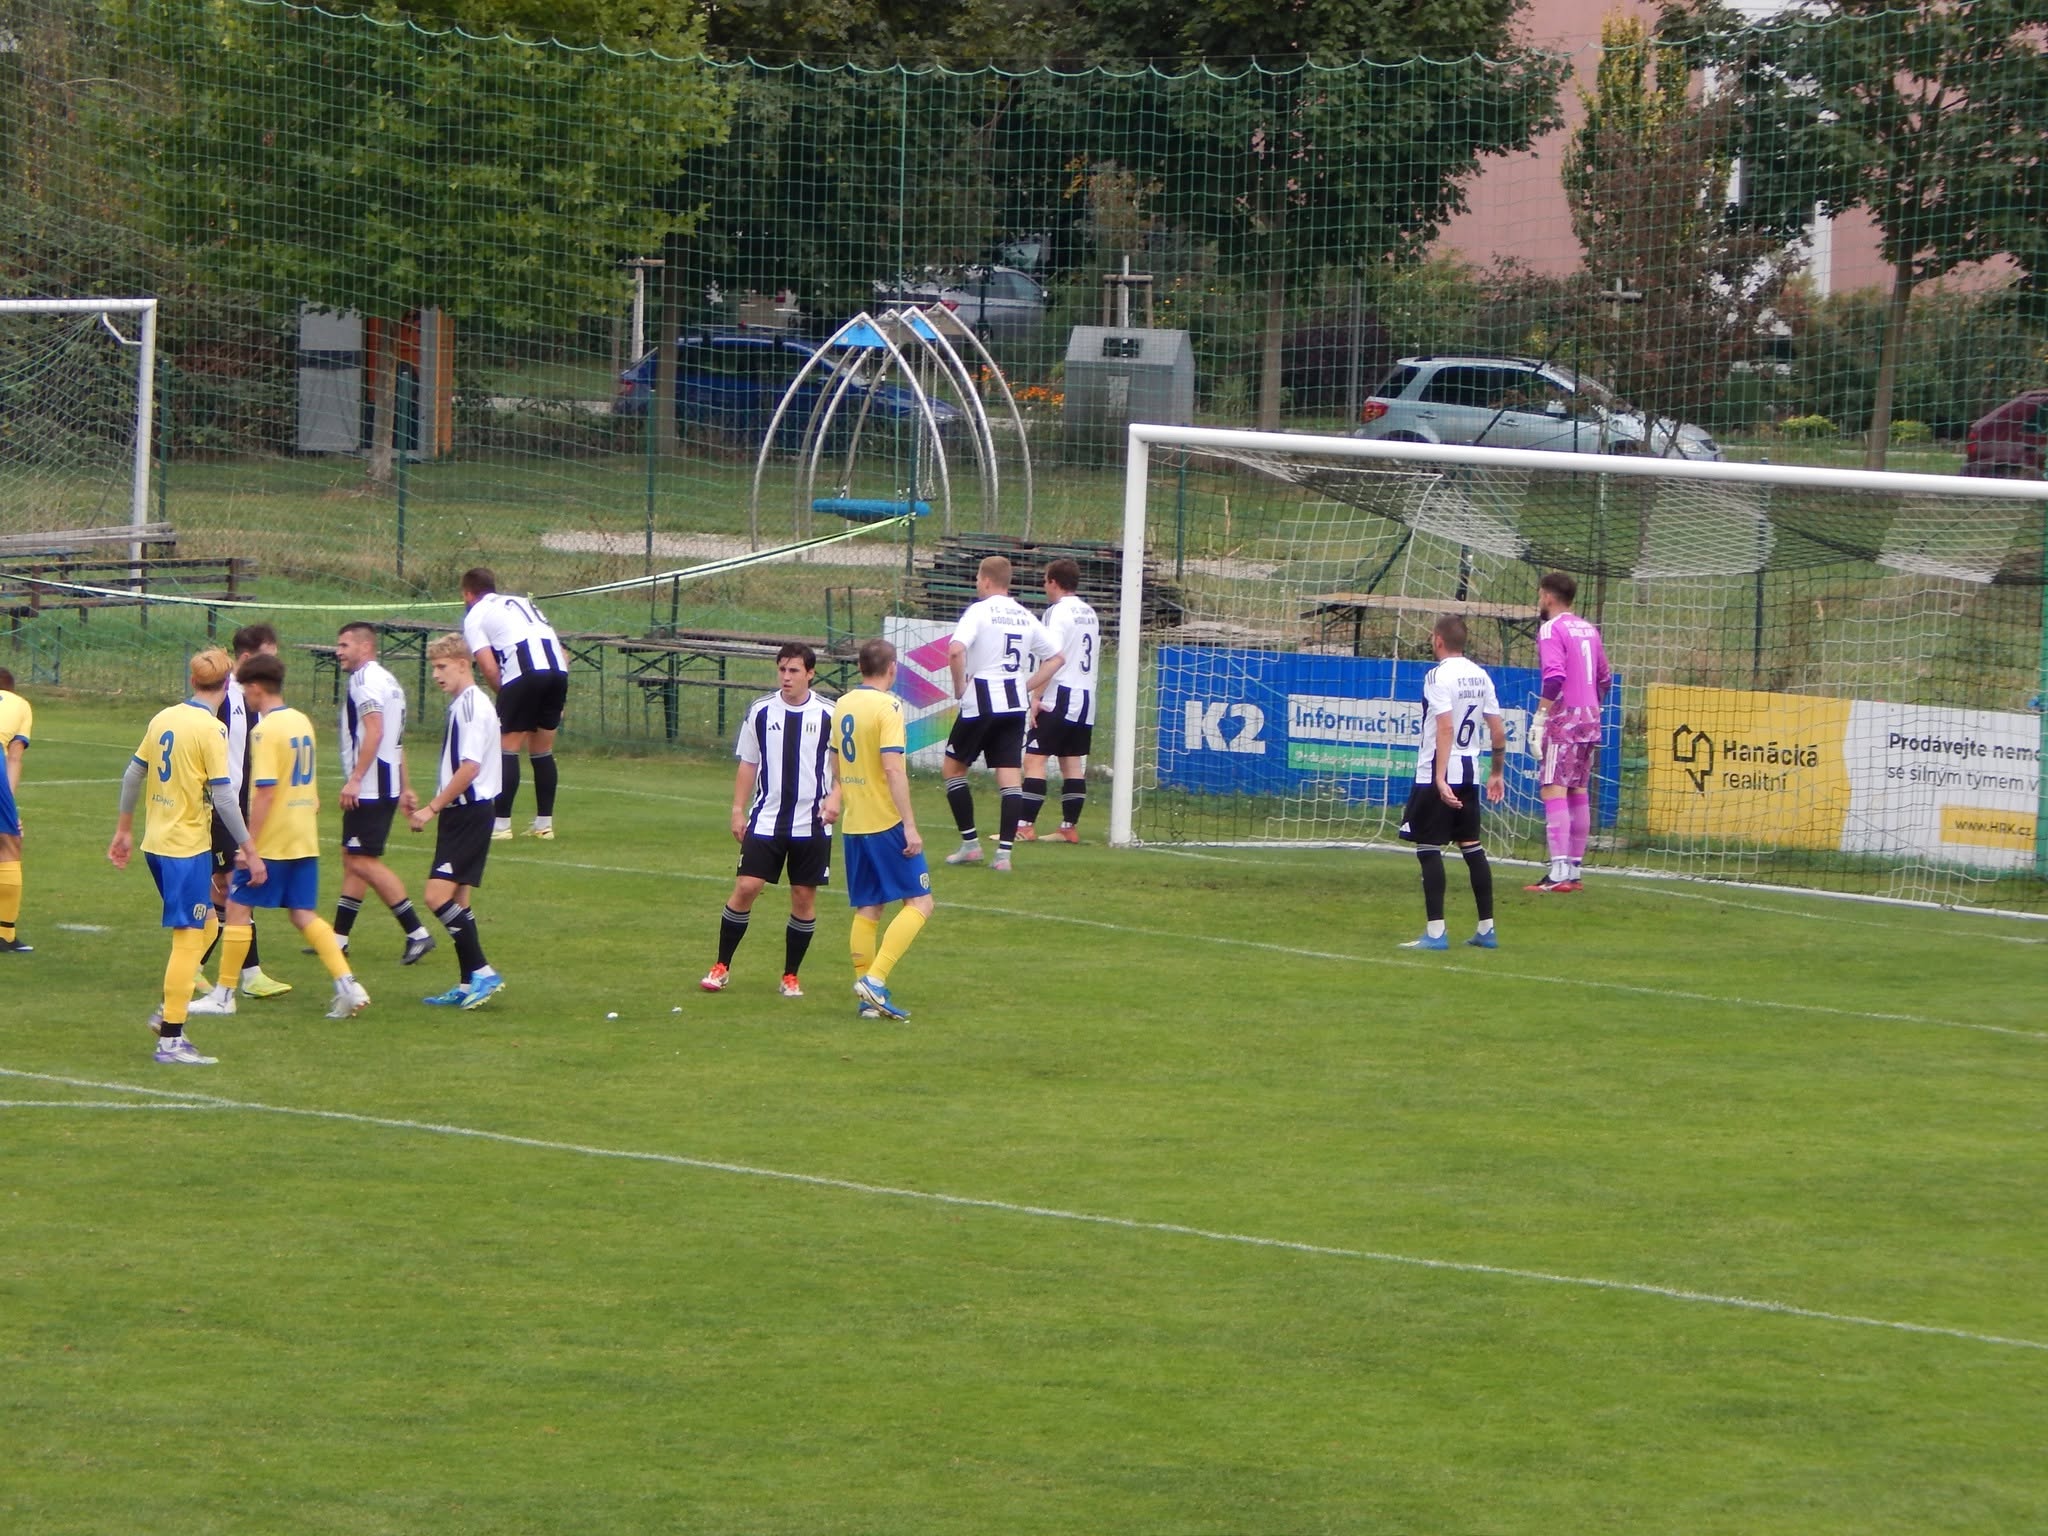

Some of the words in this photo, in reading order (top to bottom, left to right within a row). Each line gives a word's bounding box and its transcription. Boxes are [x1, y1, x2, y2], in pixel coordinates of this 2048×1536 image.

[1002, 632, 1023, 673] 5
[1079, 633, 1093, 674] 3
[1581, 639, 1593, 685] 1
[840, 713, 857, 763] 8
[1185, 700, 1266, 755] K2
[1295, 705, 1406, 735] Informační
[1456, 704, 1479, 749] 6
[157, 729, 175, 783] 3
[289, 735, 314, 787] 10
[1722, 739, 1818, 768] Hanácká
[1888, 731, 1988, 760] Prodávejte
[1722, 769, 1788, 792] realitní
[1887, 766, 1906, 780] se
[1909, 765, 1962, 787] silným
[1966, 770, 2024, 791] týmem
